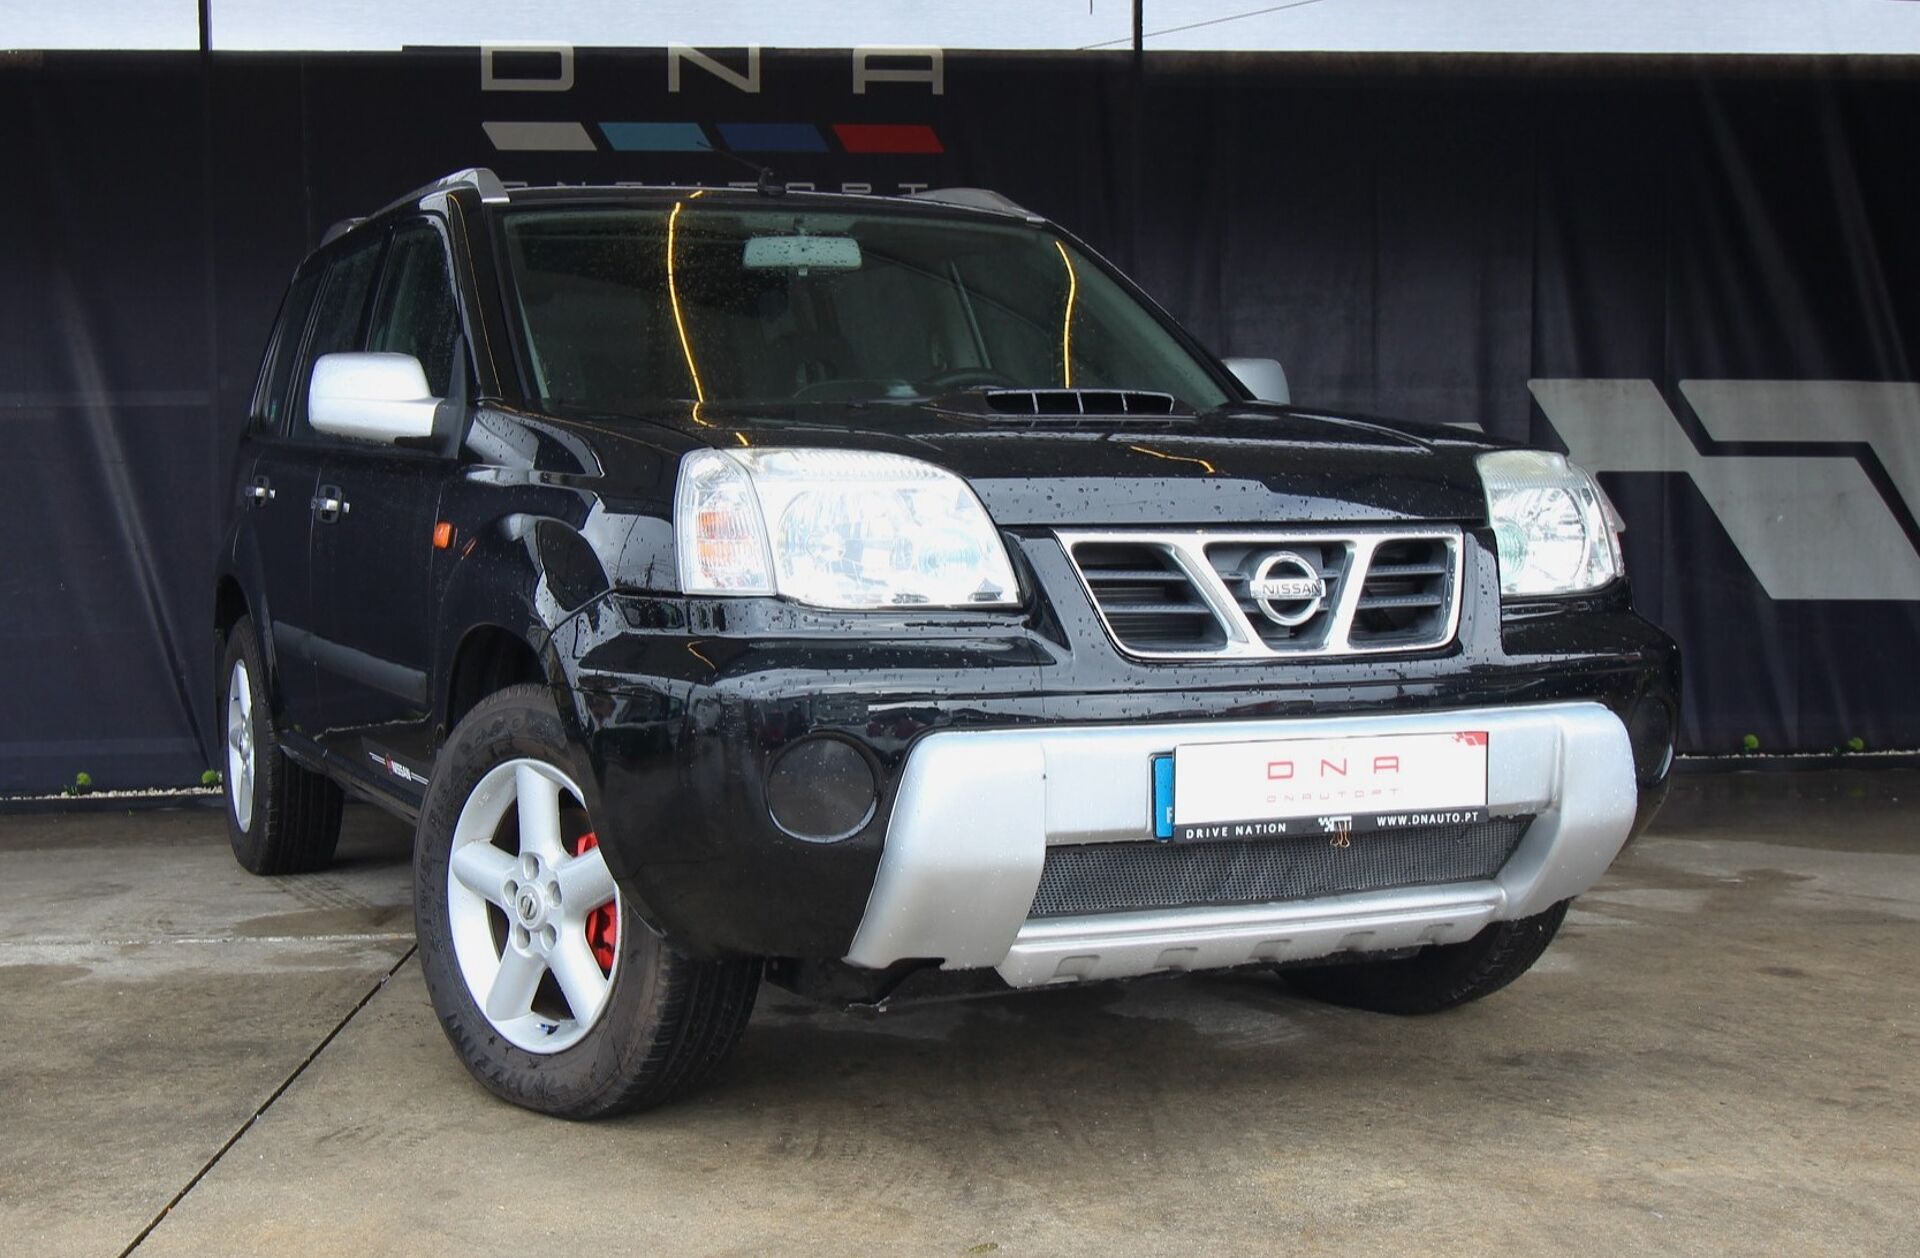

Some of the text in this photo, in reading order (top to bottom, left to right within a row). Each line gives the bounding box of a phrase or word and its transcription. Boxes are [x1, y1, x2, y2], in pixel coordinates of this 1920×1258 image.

[480, 40, 944, 95] DNA
[1262, 583, 1321, 597] NISSAN
[1267, 755, 1400, 780] DNA
[1376, 811, 1479, 827] WWW.DNAUTO.PT
[1185, 822, 1287, 840] DRIVE NATION
